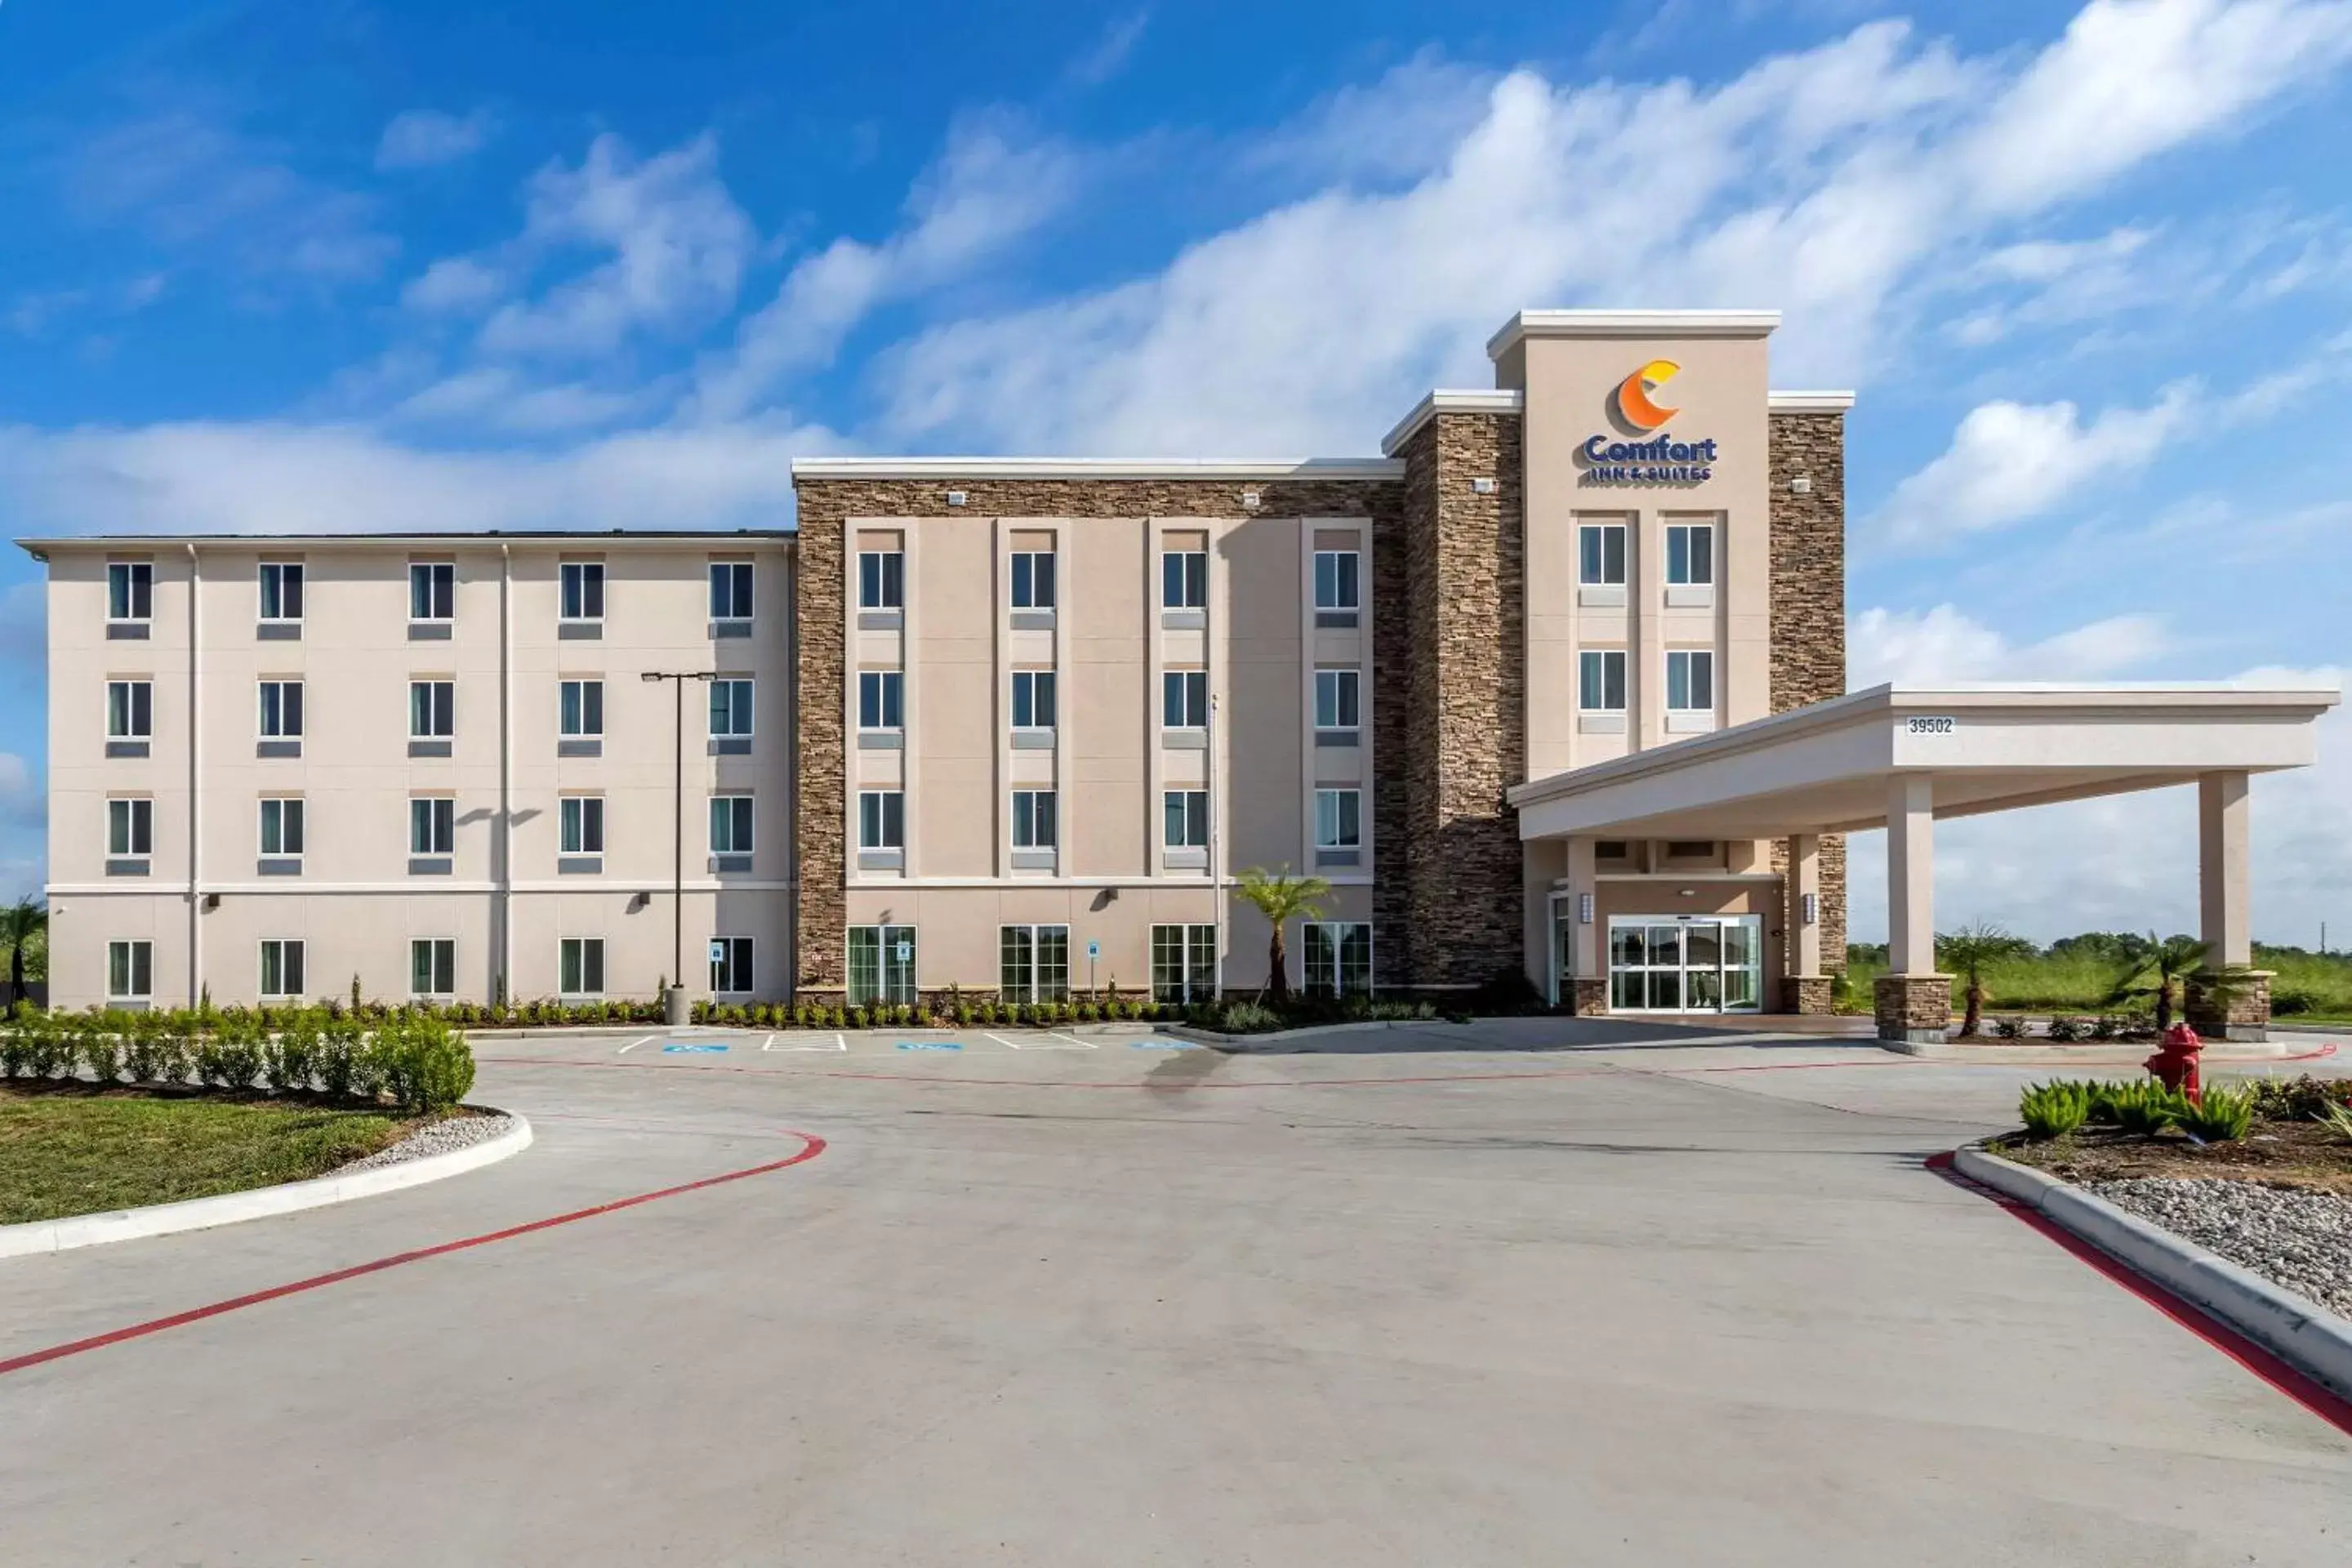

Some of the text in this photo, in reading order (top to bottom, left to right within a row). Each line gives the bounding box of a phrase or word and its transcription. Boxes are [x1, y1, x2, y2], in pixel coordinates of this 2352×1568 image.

[1584, 433, 1717, 461] Comfort
[1591, 466, 1712, 481] INN & SUITES
[1909, 719, 1952, 733] 39502
